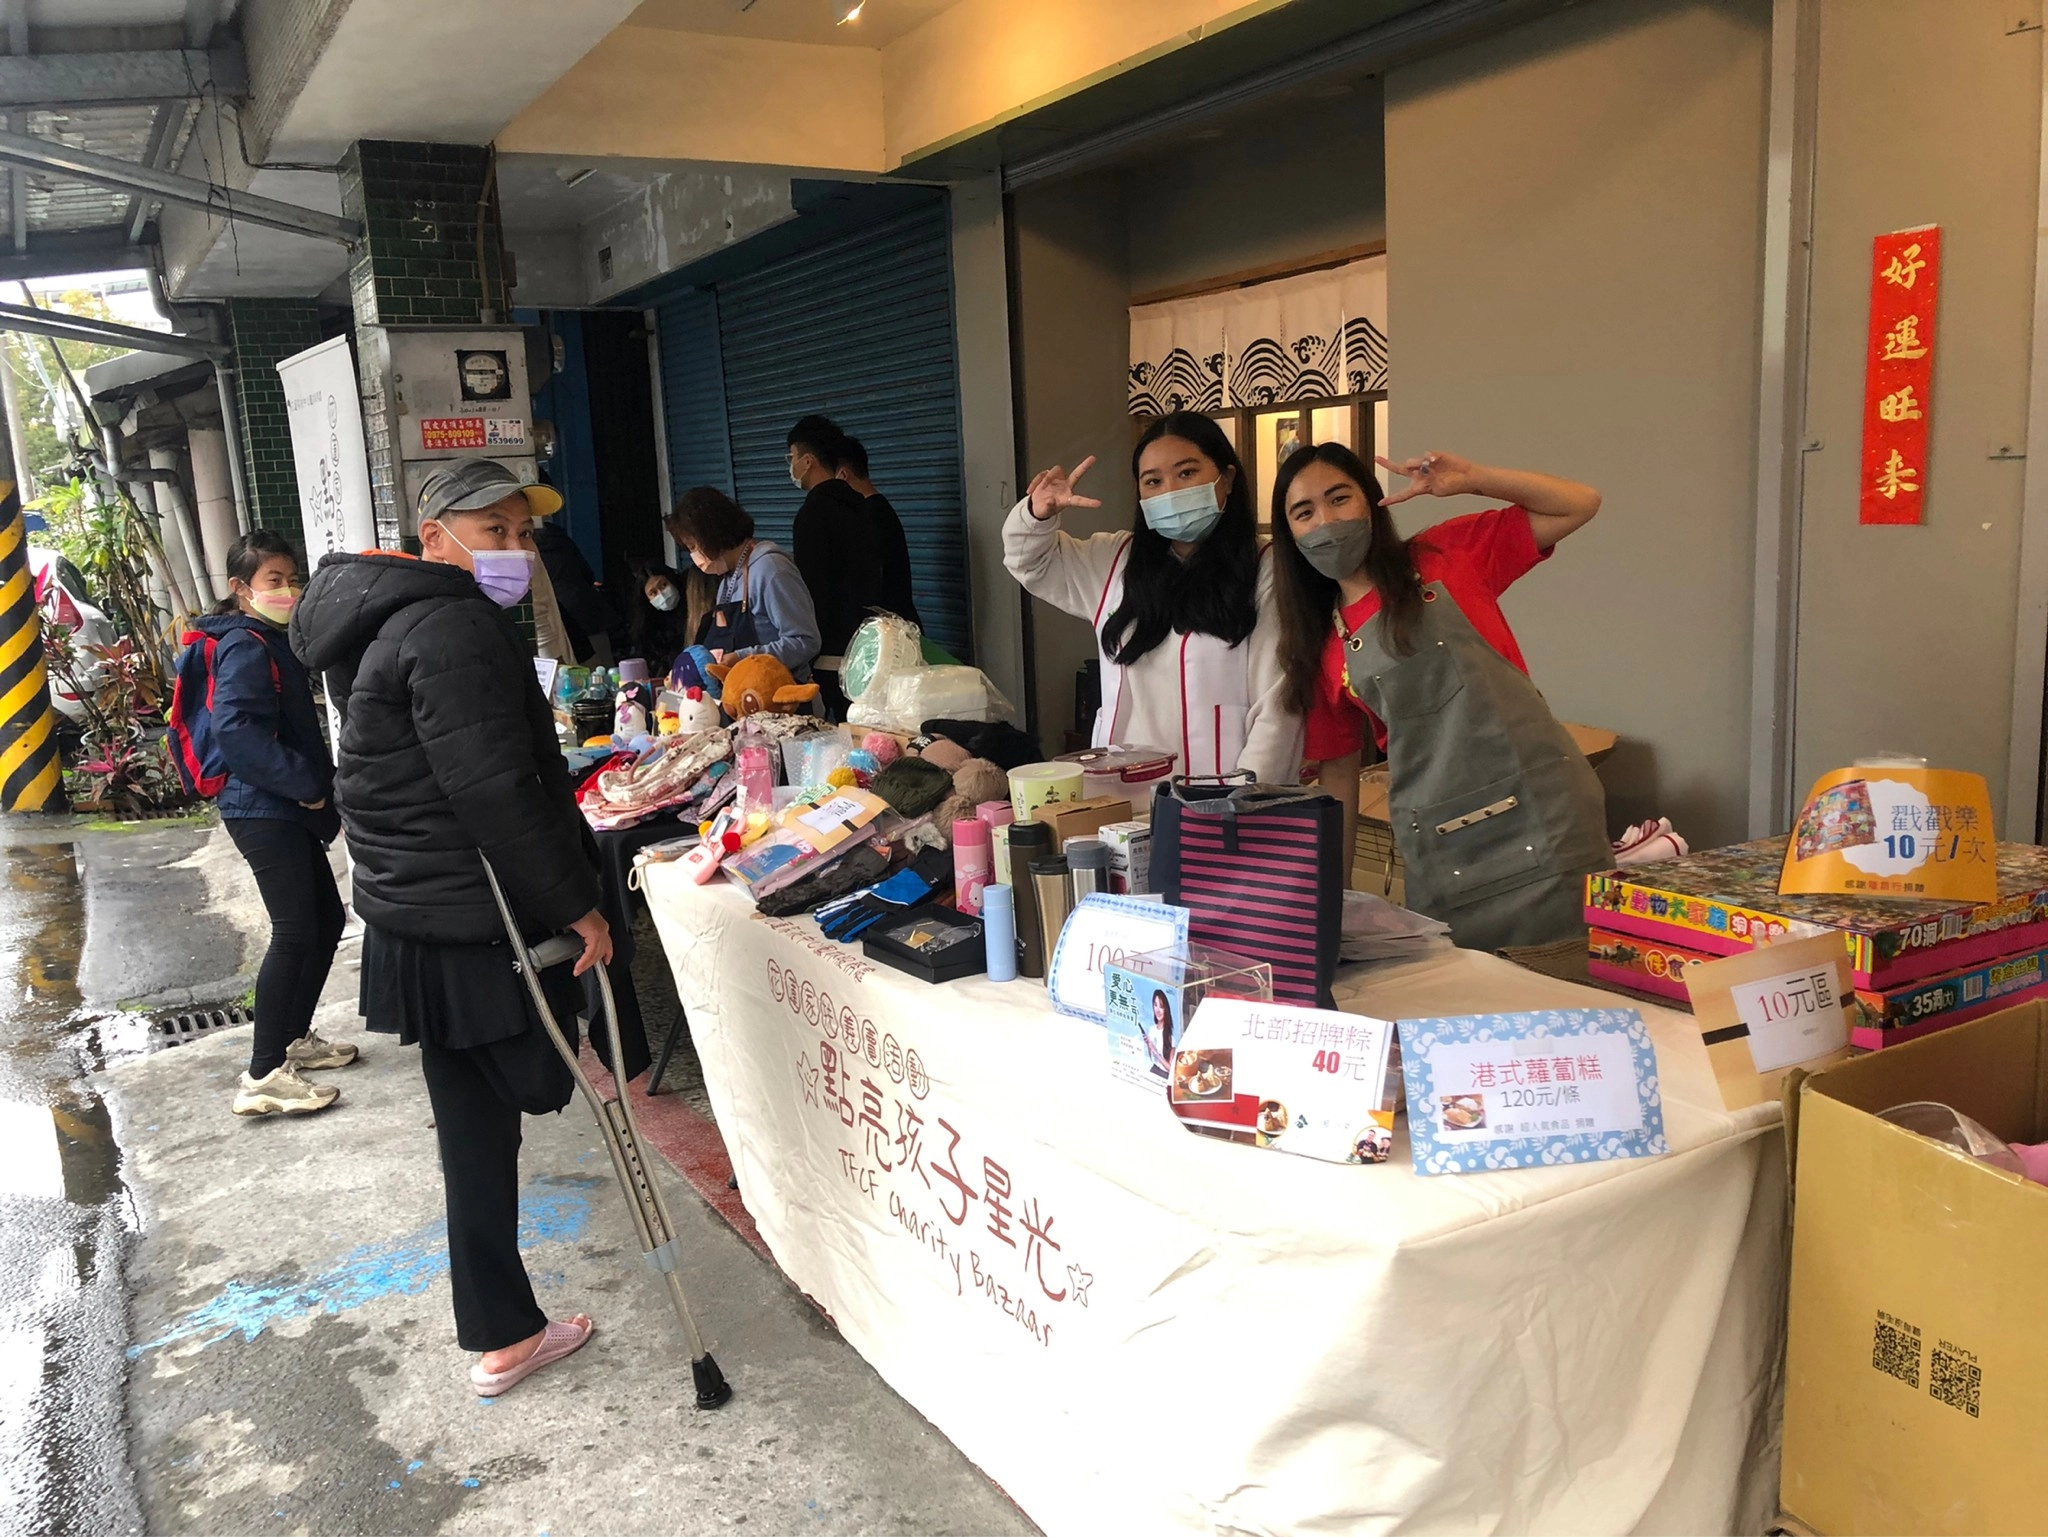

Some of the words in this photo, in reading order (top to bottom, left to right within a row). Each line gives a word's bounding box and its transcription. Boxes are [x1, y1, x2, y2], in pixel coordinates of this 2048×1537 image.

[488, 437, 524, 445] 8539699
[1891, 805, 1979, 831] 戳戳樂
[1884, 834, 1986, 864] 10元/次
[1630, 888, 1728, 932] 動物大家族
[1900, 922, 1938, 950] 70洞
[1111, 972, 1134, 993] 愛心
[1757, 972, 1834, 1022] 10元區
[1242, 1013, 1373, 1051] 北部招牌粽
[1312, 1050, 1366, 1081] 40元
[1470, 1054, 1603, 1088] 港式蘿蔔糕
[1501, 1086, 1581, 1108] 120元/條
[820, 1041, 1066, 1302] 點亮孩子星光
[838, 1148, 878, 1200] TFCF
[889, 1191, 962, 1296] Charity
[970, 1250, 1053, 1346] Bazaar
[1939, 1338, 1978, 1363] PLAYER
